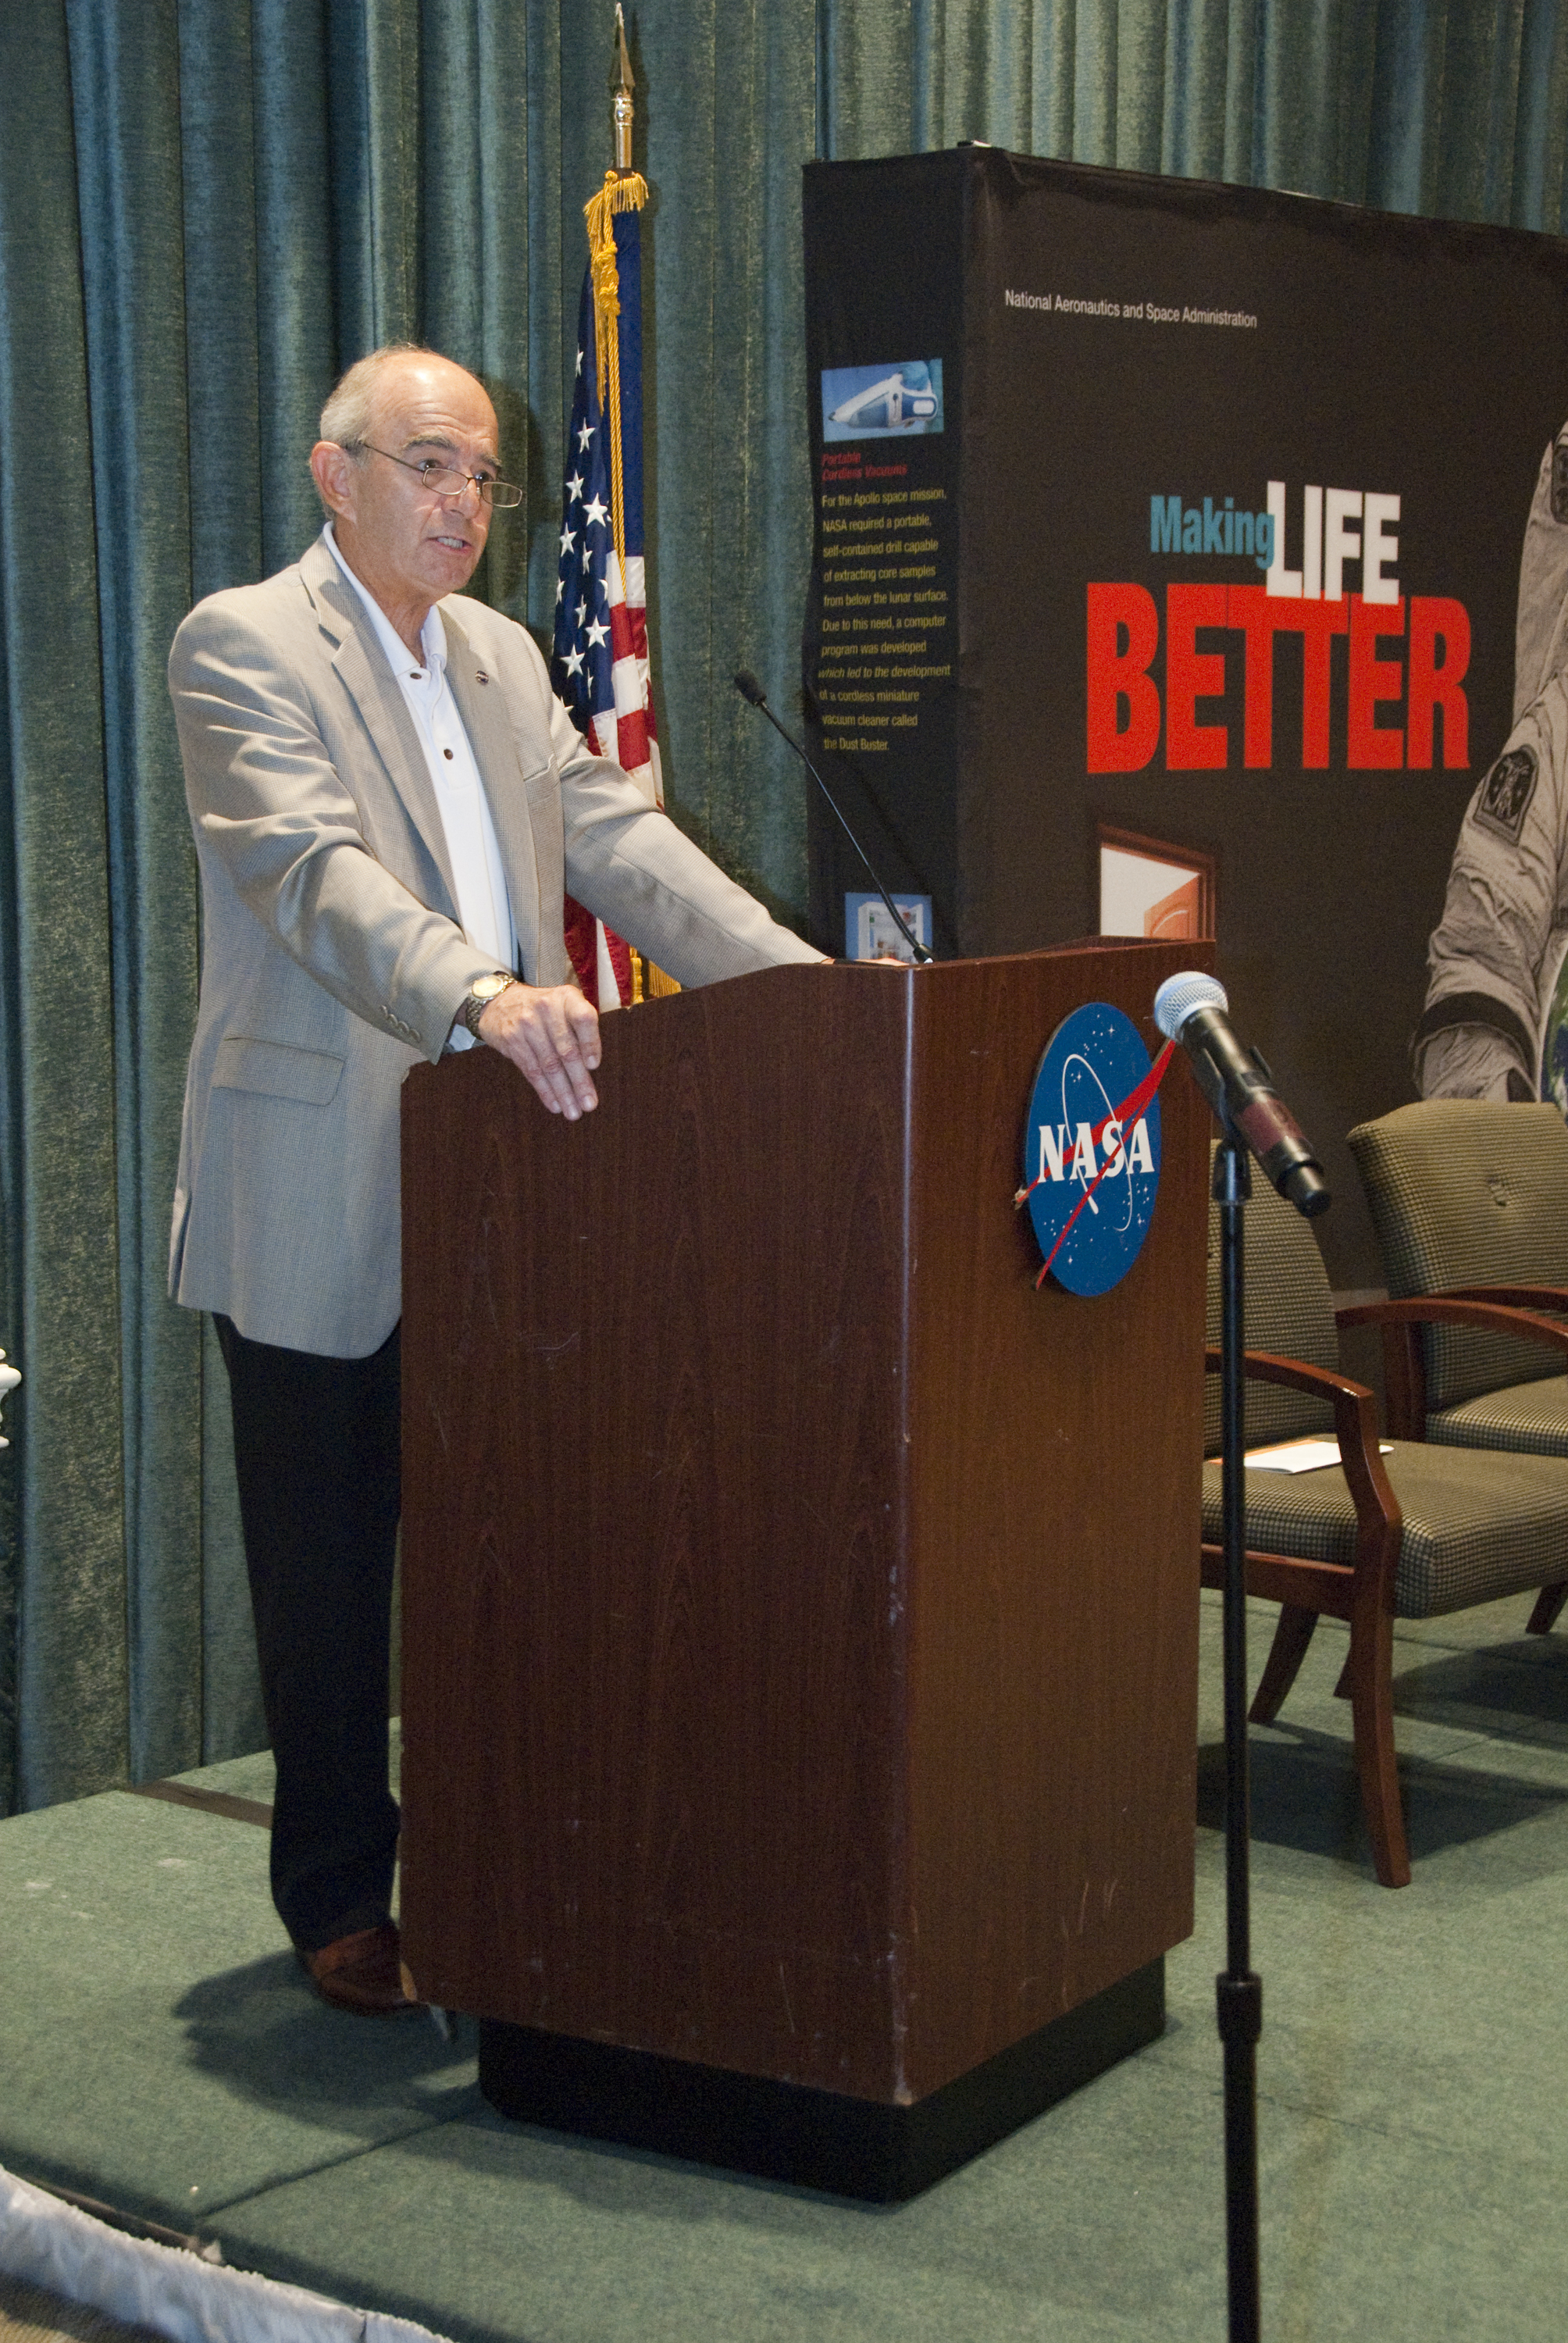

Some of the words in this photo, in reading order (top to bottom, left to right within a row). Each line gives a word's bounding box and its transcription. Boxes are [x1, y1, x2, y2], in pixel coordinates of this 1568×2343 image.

[1005, 289, 1052, 311] National
[1054, 294, 1121, 318] Aeronautics
[1123, 302, 1143, 320] and
[1146, 302, 1180, 323] Space
[1182, 306, 1257, 329] Administration
[822, 495, 836, 507] For
[839, 494, 852, 505] the
[853, 493, 880, 506] Apollo
[882, 491, 907, 505] space
[823, 519, 847, 532] NASA
[849, 516, 884, 531] required
[886, 518, 892, 529] a
[894, 513, 932, 530] portable,
[823, 542, 883, 558] self-contained
[886, 540, 902, 554] drill
[904, 539, 938, 554] capable
[1150, 494, 1275, 570] Making
[1266, 480, 1402, 605] LIFE
[824, 569, 832, 582] of
[834, 568, 876, 582] extracting
[878, 568, 897, 580] core
[900, 565, 935, 578] samples
[824, 594, 843, 607] from
[845, 593, 871, 605] below
[873, 591, 887, 604] the
[889, 591, 912, 603] lunar
[822, 619, 839, 632] Due
[843, 619, 850, 630] to
[852, 618, 868, 630] this
[870, 616, 894, 630] need,
[896, 618, 902, 629] a
[903, 615, 946, 629] computer
[821, 644, 858, 658] program
[861, 644, 878, 654] was
[881, 640, 927, 654] developed
[818, 667, 845, 678] which
[846, 666, 862, 679] led
[863, 666, 872, 678] to
[874, 665, 889, 678] the
[891, 665, 951, 679] development
[1087, 582, 1471, 774] BETTER
[820, 689, 828, 701] of
[830, 691, 836, 701] a
[837, 690, 875, 702] cordless
[876, 689, 920, 701] miniature
[822, 715, 856, 726] vacuum
[857, 714, 889, 727] cleaner
[892, 714, 918, 727] called
[824, 737, 837, 750] the
[839, 737, 859, 751] Dust
[861, 738, 889, 751] Buster.
[1037, 1118, 1155, 1183] NASA
